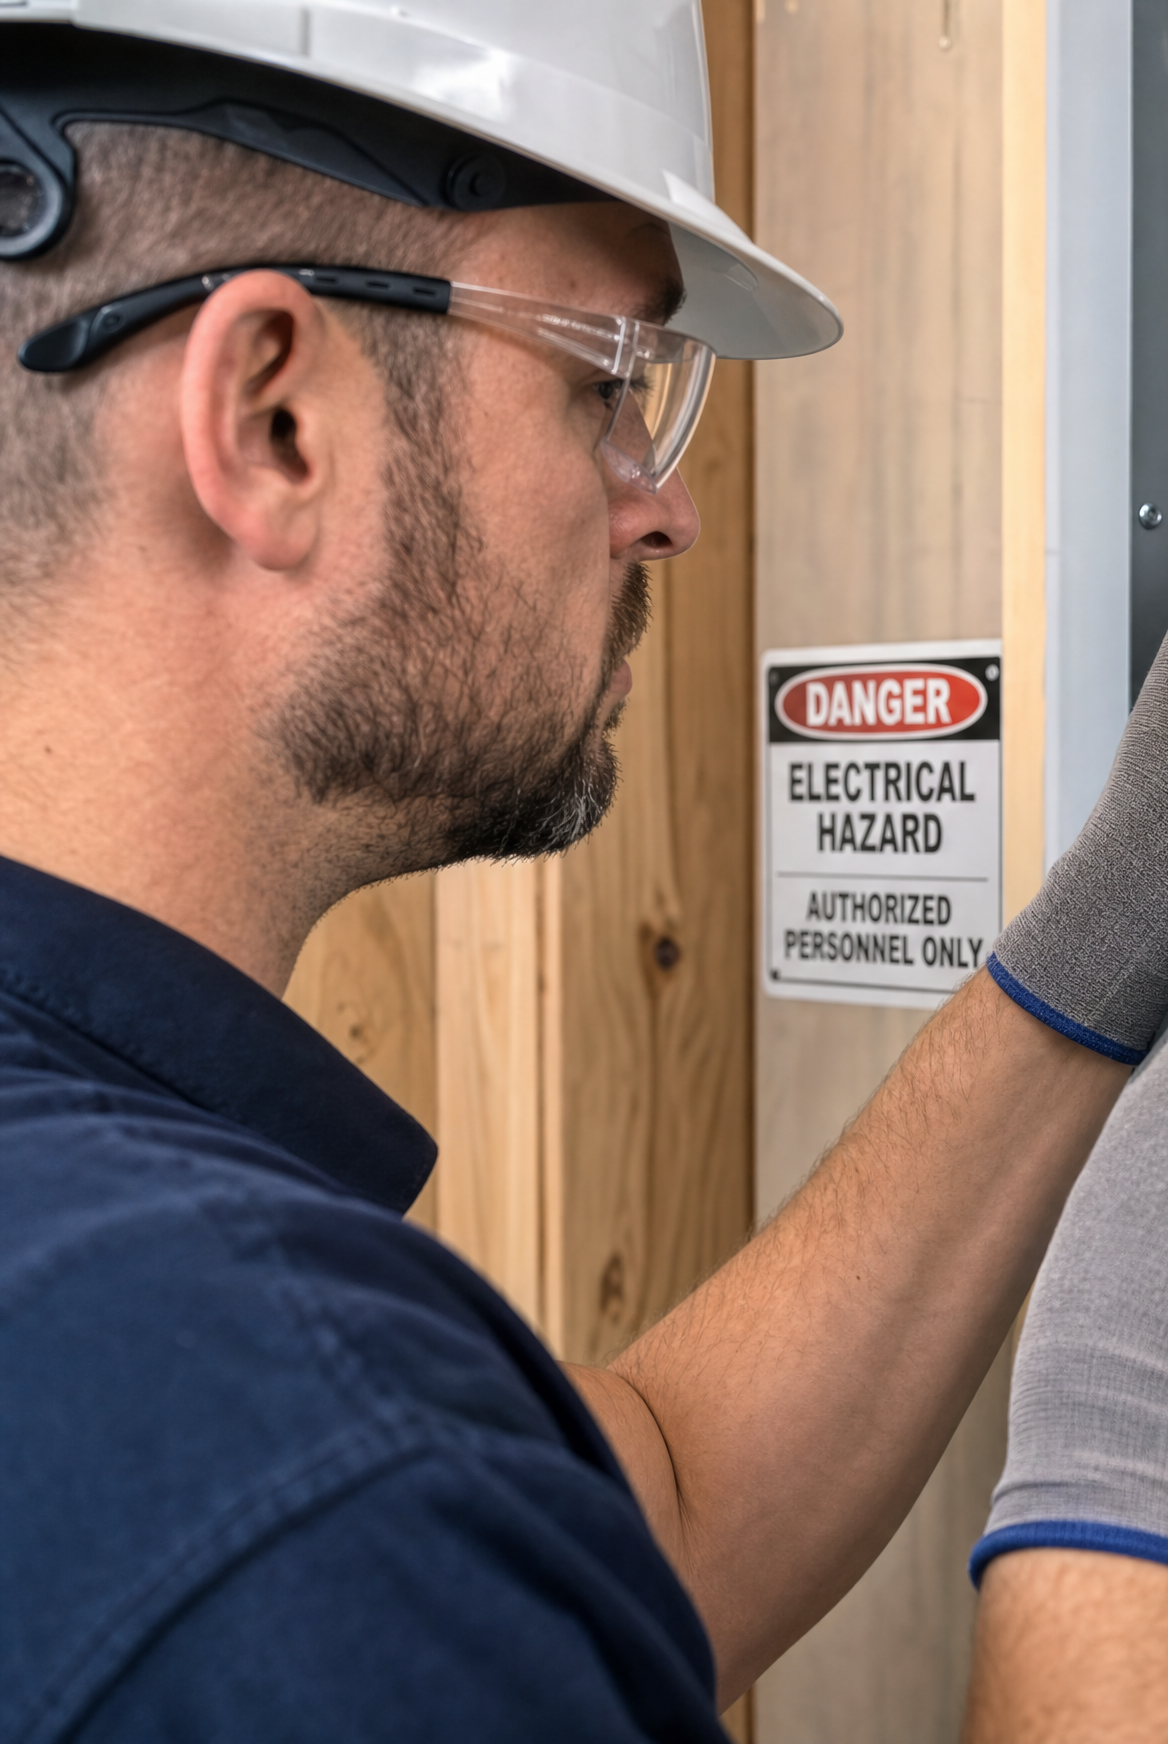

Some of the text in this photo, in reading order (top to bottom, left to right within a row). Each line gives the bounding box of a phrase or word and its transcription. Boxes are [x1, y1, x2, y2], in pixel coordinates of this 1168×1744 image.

[806, 678, 952, 726] DANGER
[789, 761, 975, 802] ELECTRICAL
[817, 812, 943, 853] HAZARD
[806, 891, 952, 926] AUTHORIZED
[785, 929, 983, 968] PERSONNEL ONLY
